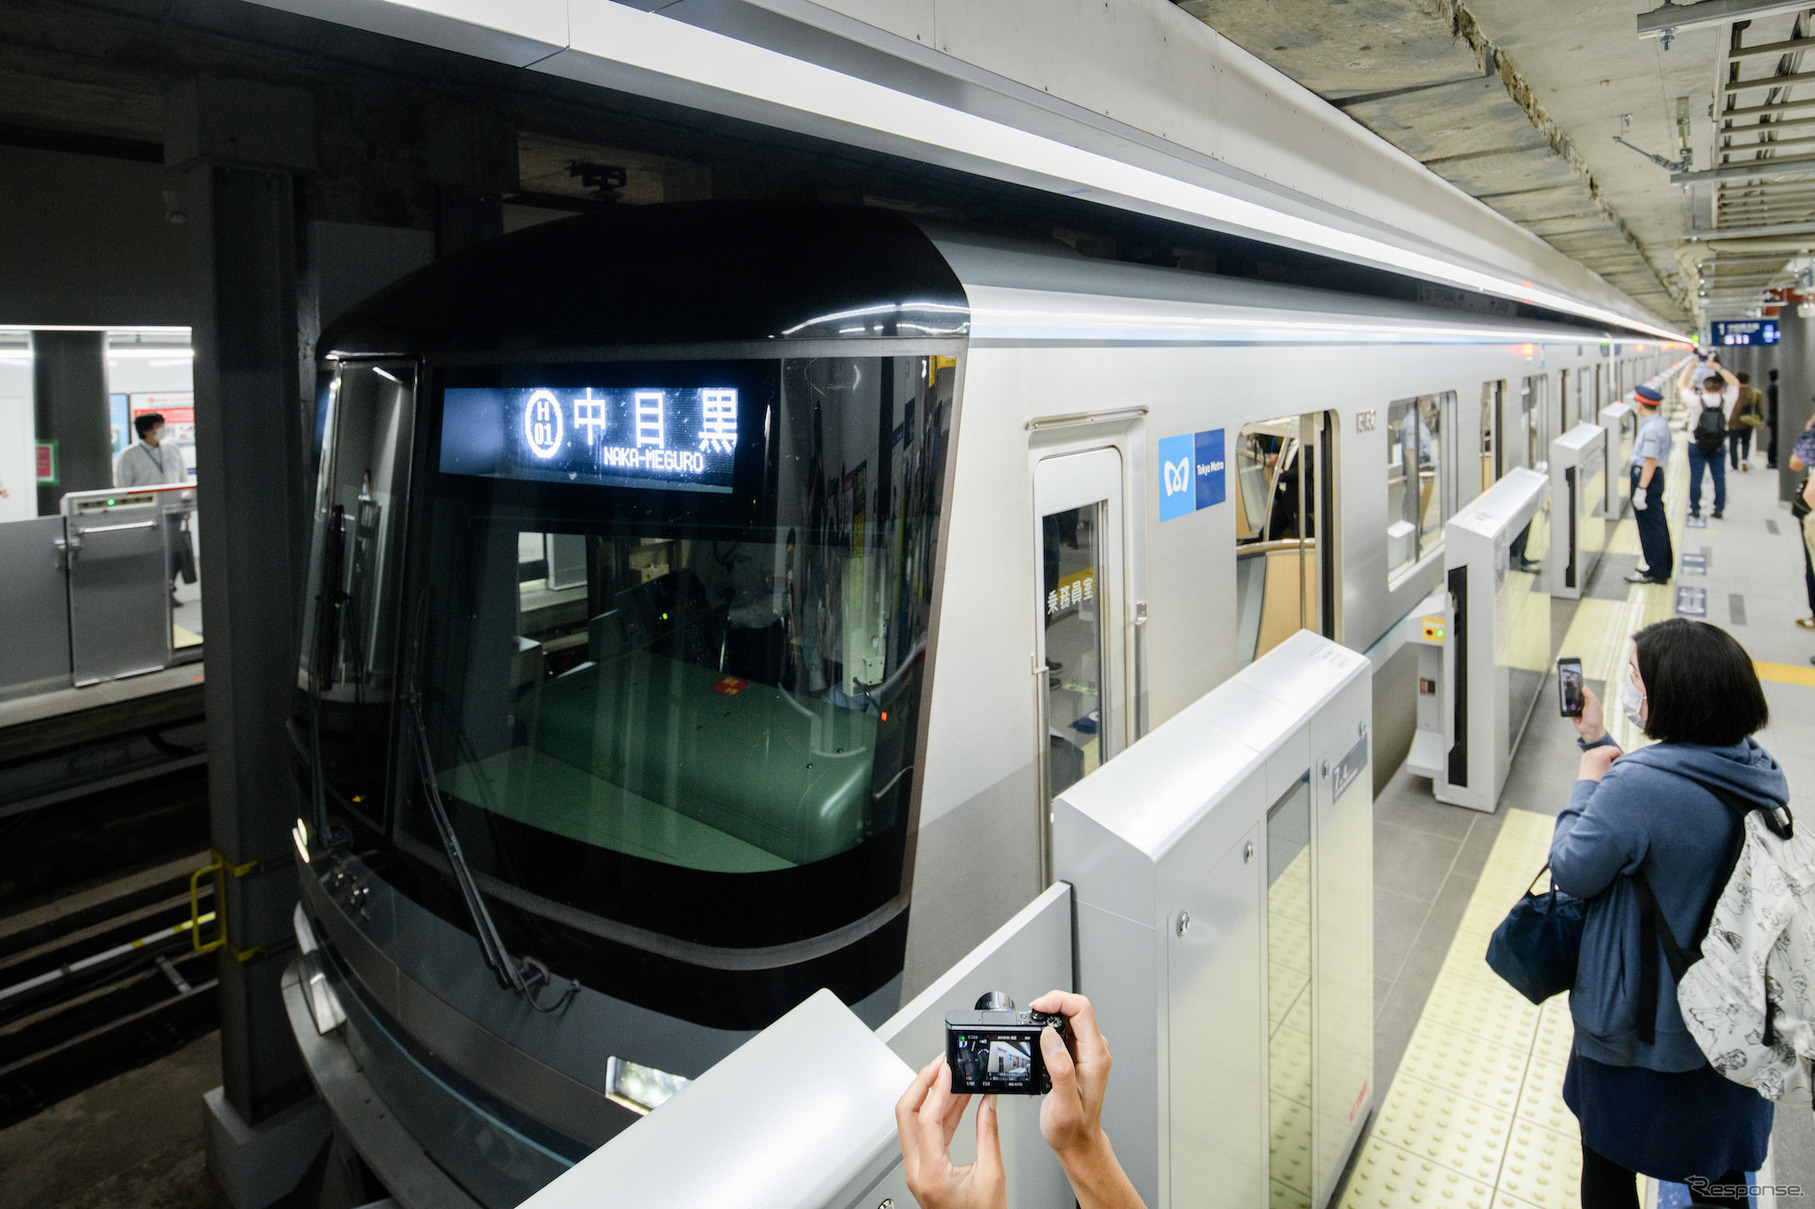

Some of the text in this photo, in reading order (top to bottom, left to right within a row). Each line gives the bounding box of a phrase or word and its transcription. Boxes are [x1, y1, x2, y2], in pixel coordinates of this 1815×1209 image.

[537, 401, 550, 421] H
[573, 387, 739, 454] 中目黒
[533, 422, 554, 446] 01
[603, 446, 703, 473] NAKA-MEGURO
[1196, 461, 1224, 477] Tokyo Metro
[1047, 577, 1094, 615] 乗務員室
